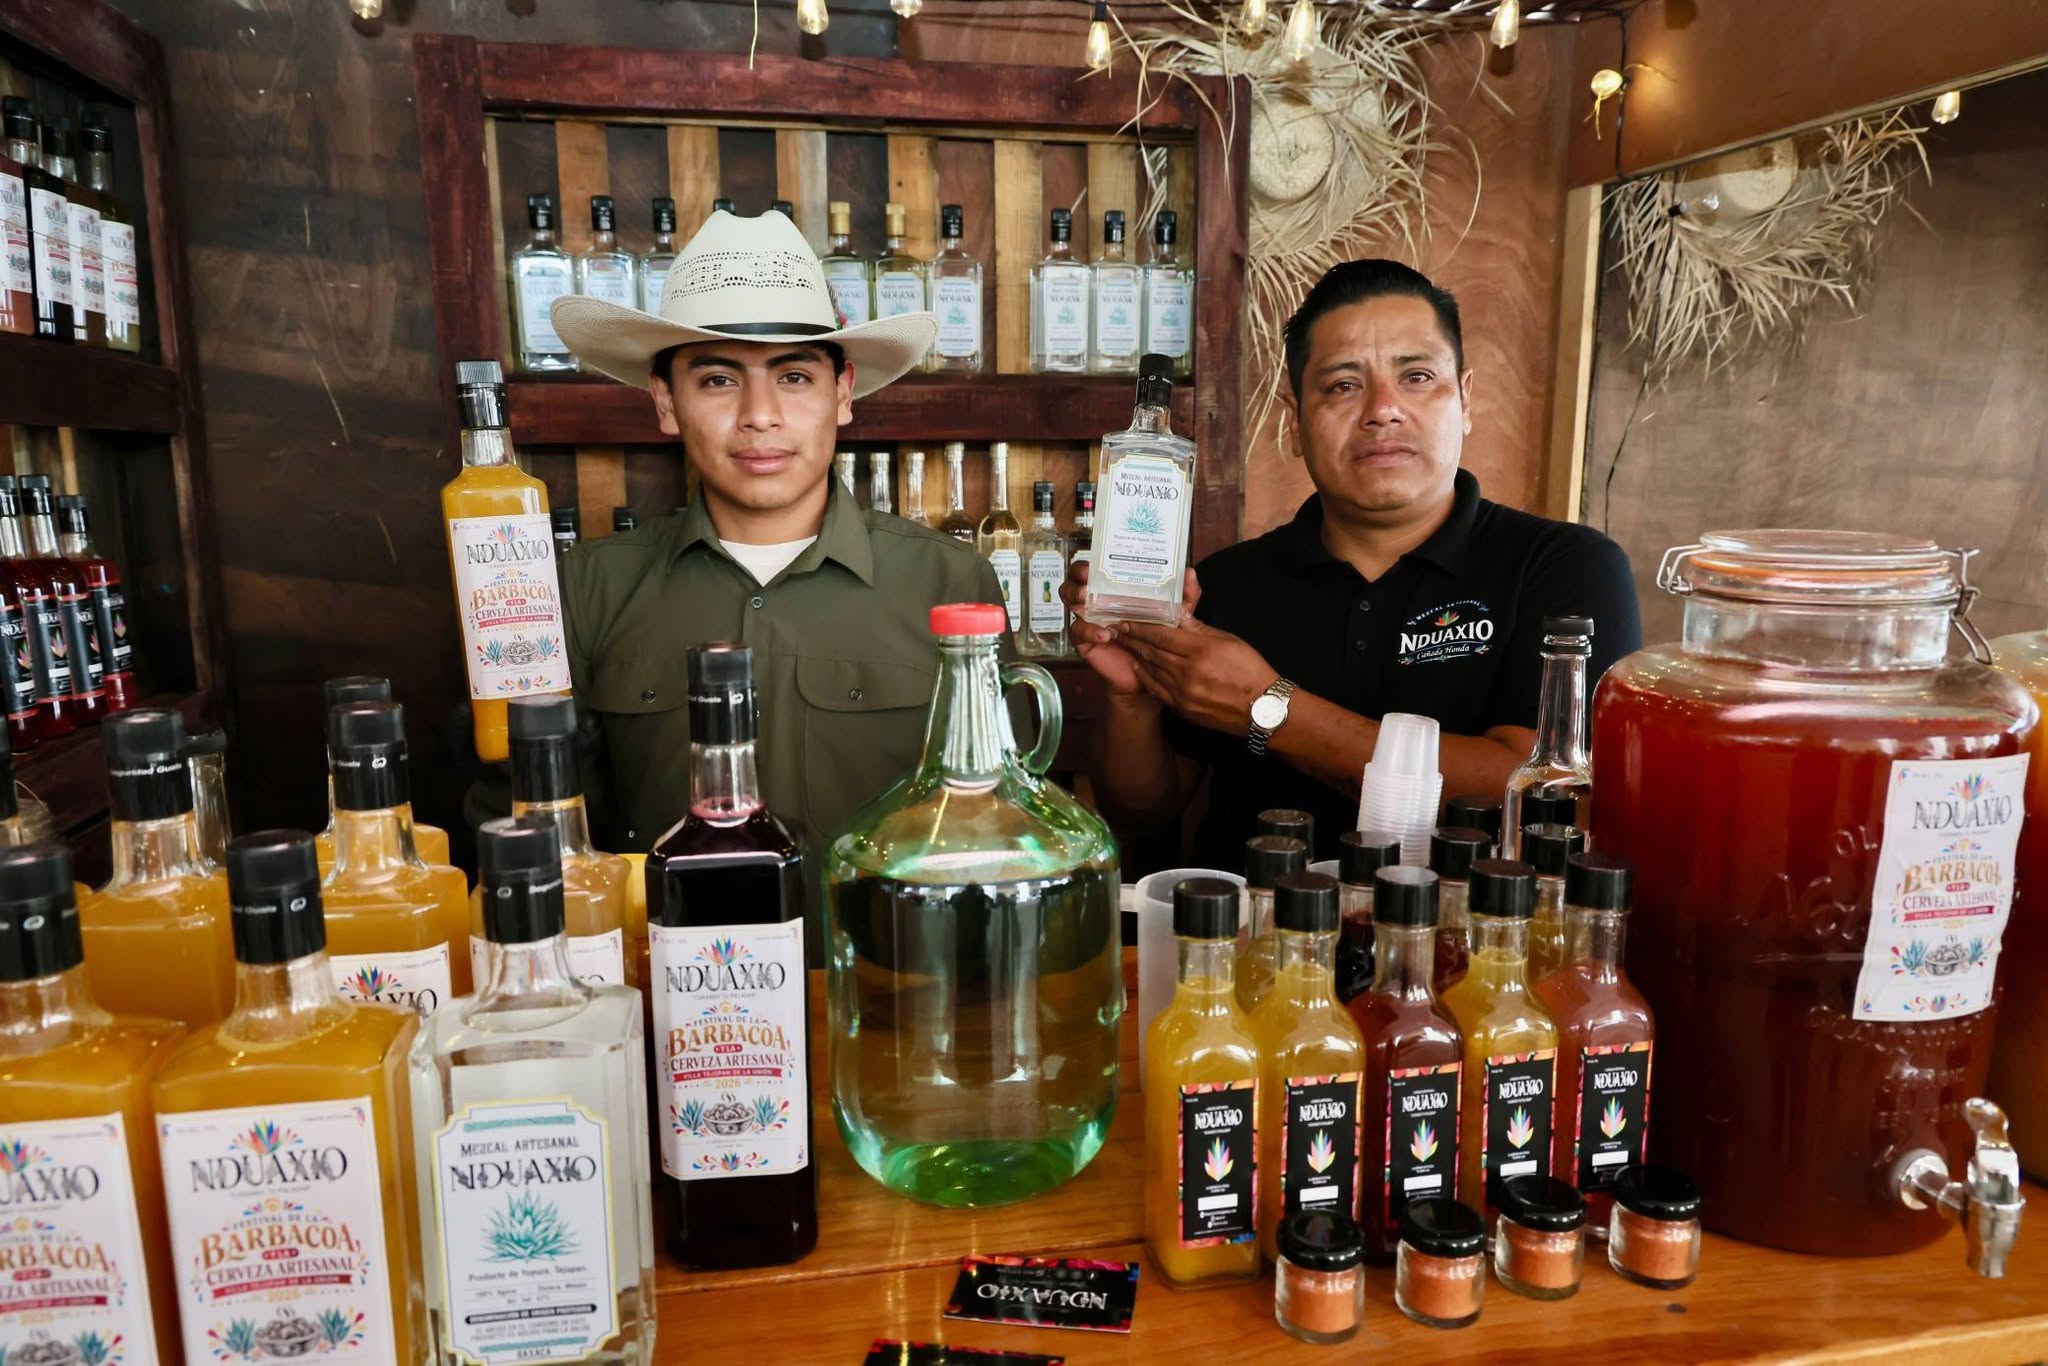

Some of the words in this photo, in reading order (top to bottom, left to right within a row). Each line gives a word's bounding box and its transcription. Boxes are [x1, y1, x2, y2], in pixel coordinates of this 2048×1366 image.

[1114, 482, 1178, 501] NDUAXIO
[466, 539, 549, 565] NDUAXIO
[490, 579, 517, 588] FESTIVAL
[472, 584, 554, 611] BARBACOA
[475, 608, 512, 621] CERVEZA
[513, 604, 554, 617] ARTESANAL
[1399, 619, 1494, 655] NDUAXIO
[1912, 795, 2012, 830] NDUAXIO
[1903, 861, 2001, 896] BARBACOA
[1902, 896, 1953, 910] CERVEZA
[665, 962, 786, 993] NDUAXIO
[694, 1016, 734, 1026] FESTIVAL
[736, 1015, 746, 1023] DE
[749, 1016, 760, 1024] LA
[668, 1023, 786, 1057] BARBACOA
[671, 1056, 722, 1072] CERVEZA
[724, 1053, 786, 1067] ARTESANAL
[715, 1078, 741, 1089] 2026
[1499, 1079, 1543, 1100] NDUAXIO
[1594, 1070, 1638, 1089] NDUAXIO
[1299, 1101, 1346, 1123] NDUAXIO
[1402, 1091, 1448, 1112] NDUAXIO
[1194, 1109, 1243, 1130] NDUAXIO
[461, 1143, 508, 1157] MEZCAL
[514, 1136, 580, 1152] ARTESANAL
[190, 1146, 348, 1193] NDUAXIO
[450, 1155, 597, 1192] NDUAXIO
[233, 1215, 283, 1230] FESTIVAL
[287, 1214, 302, 1223] DE
[305, 1215, 320, 1223] LA
[200, 1223, 356, 1270] BARBACOA
[206, 1264, 274, 1287] CERVEZA
[277, 1256, 356, 1277] ARTESANAL
[976, 1283, 1109, 1310] NDUAXIO
